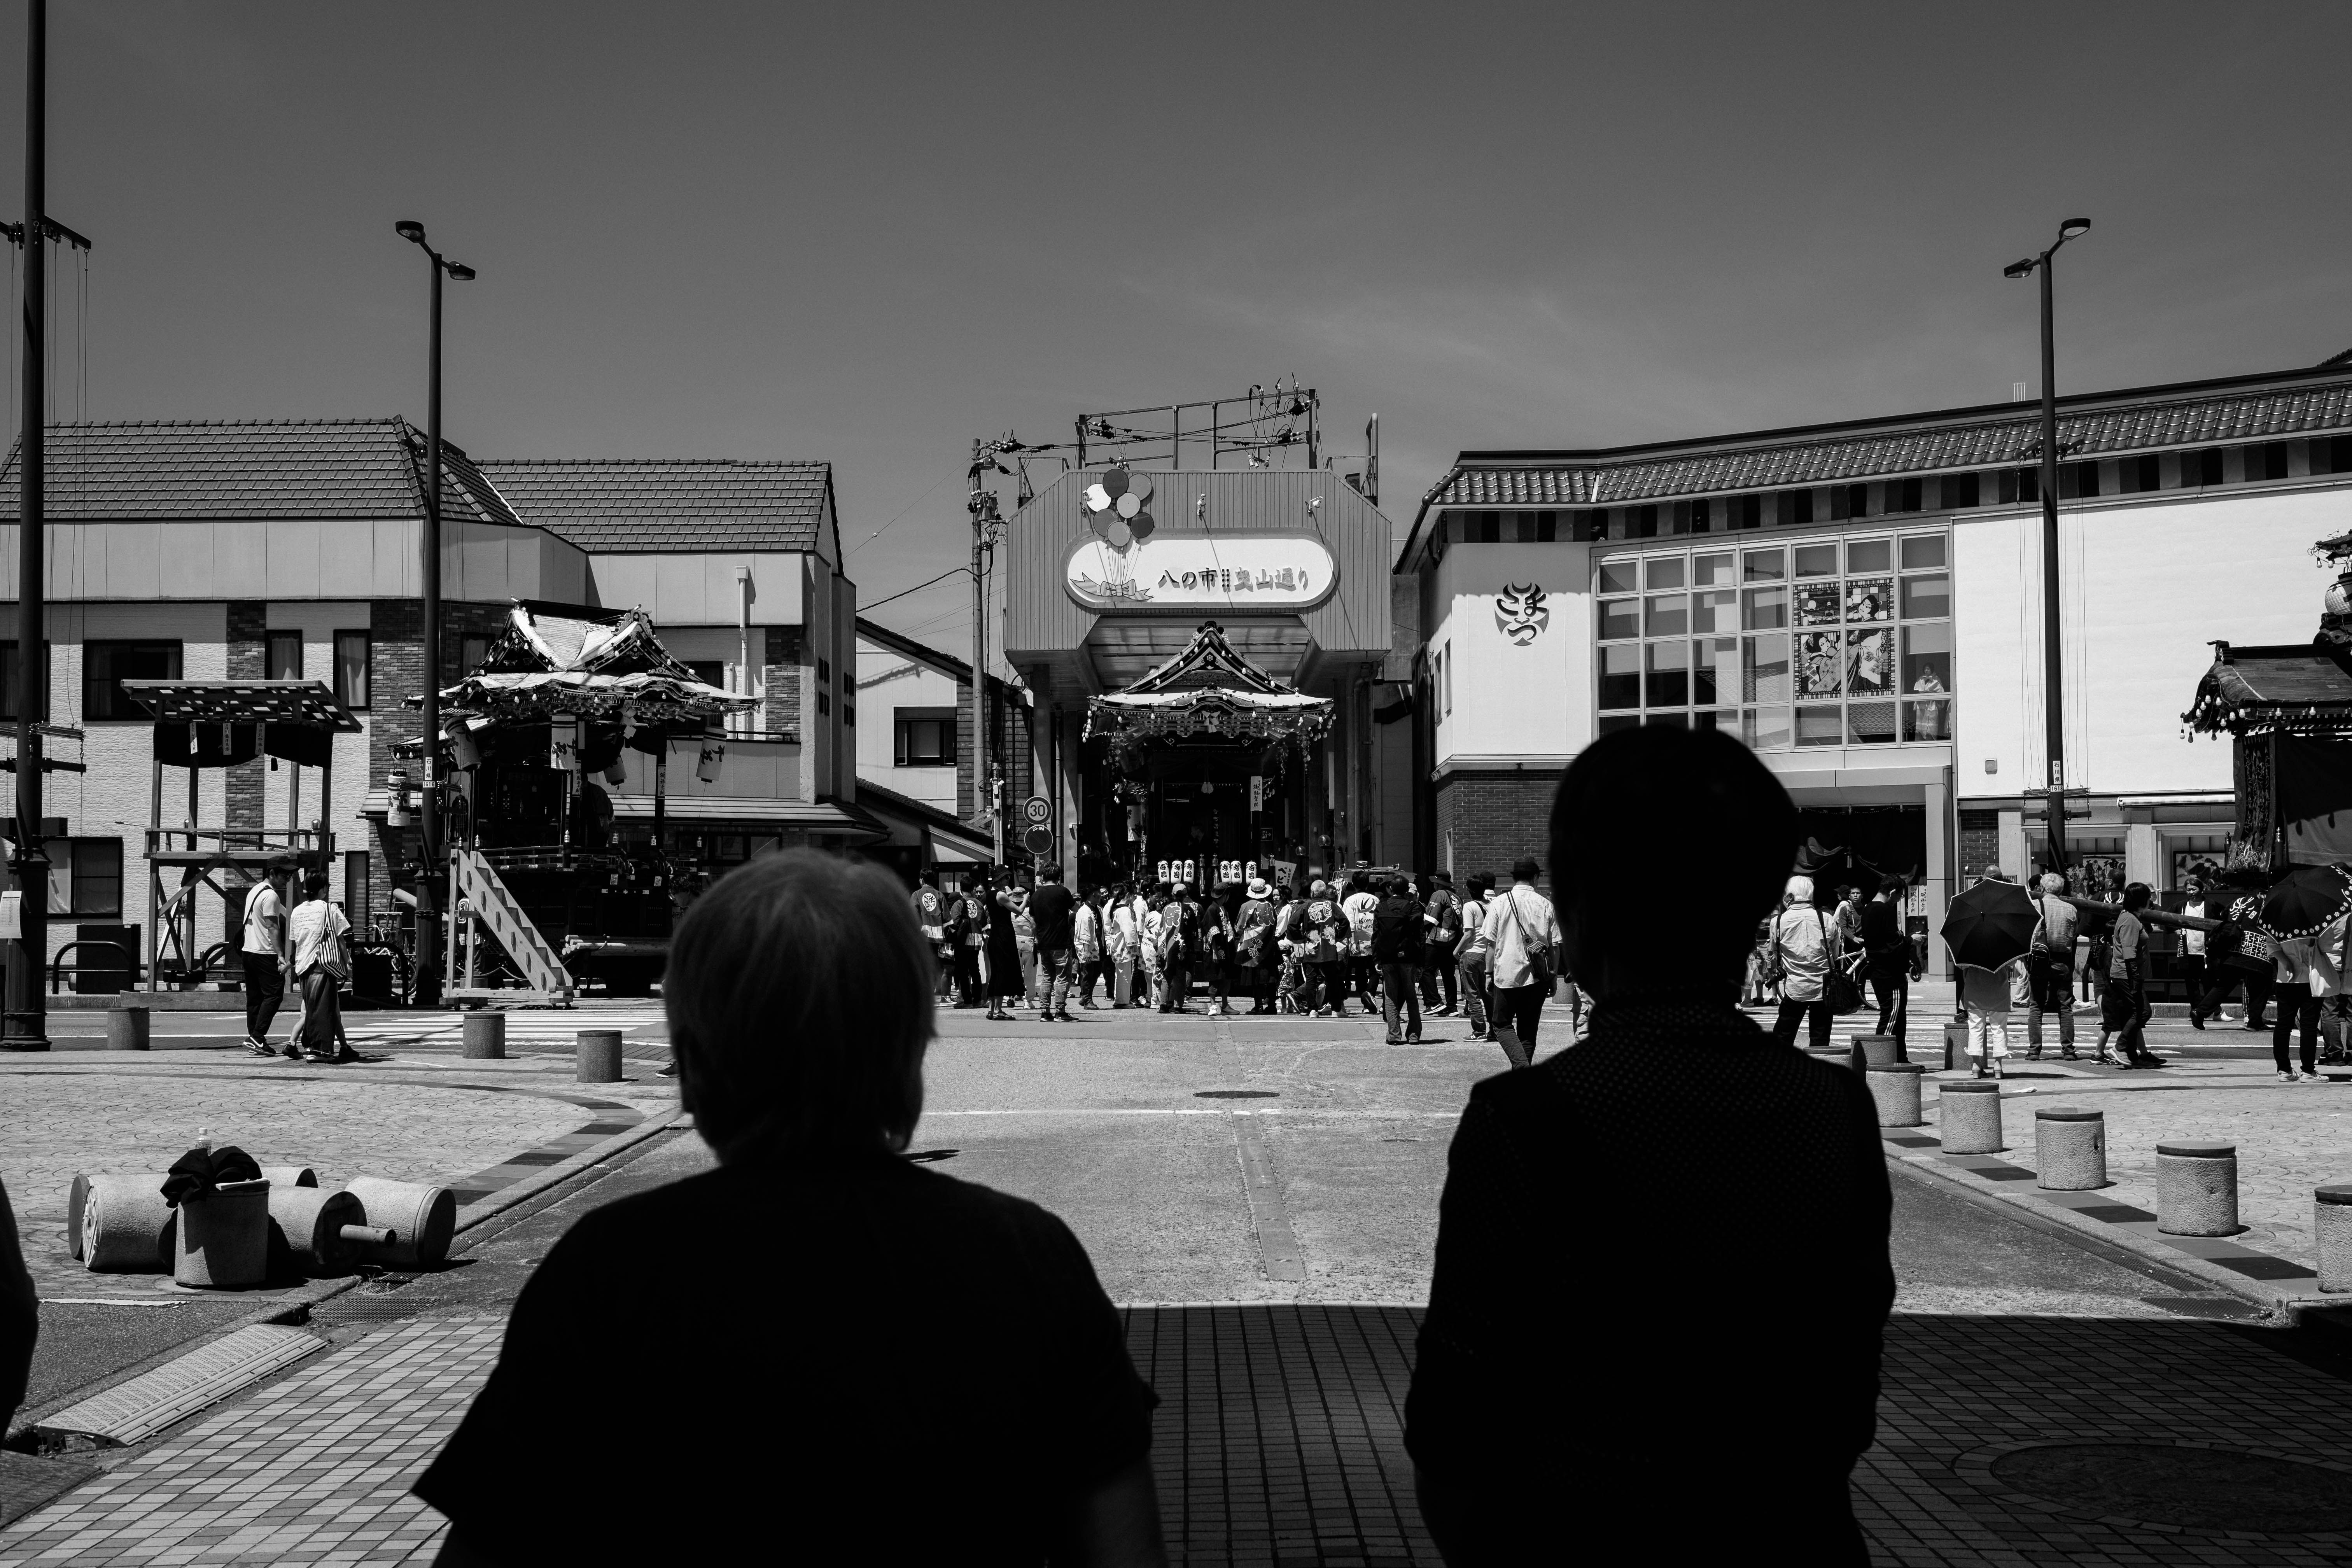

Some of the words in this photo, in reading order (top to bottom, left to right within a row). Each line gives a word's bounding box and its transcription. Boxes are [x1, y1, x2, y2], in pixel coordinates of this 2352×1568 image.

[1158, 567, 1218, 593] 八の市
[1030, 805, 1045, 817] 30
[1277, 866, 1287, 887] ベビ
